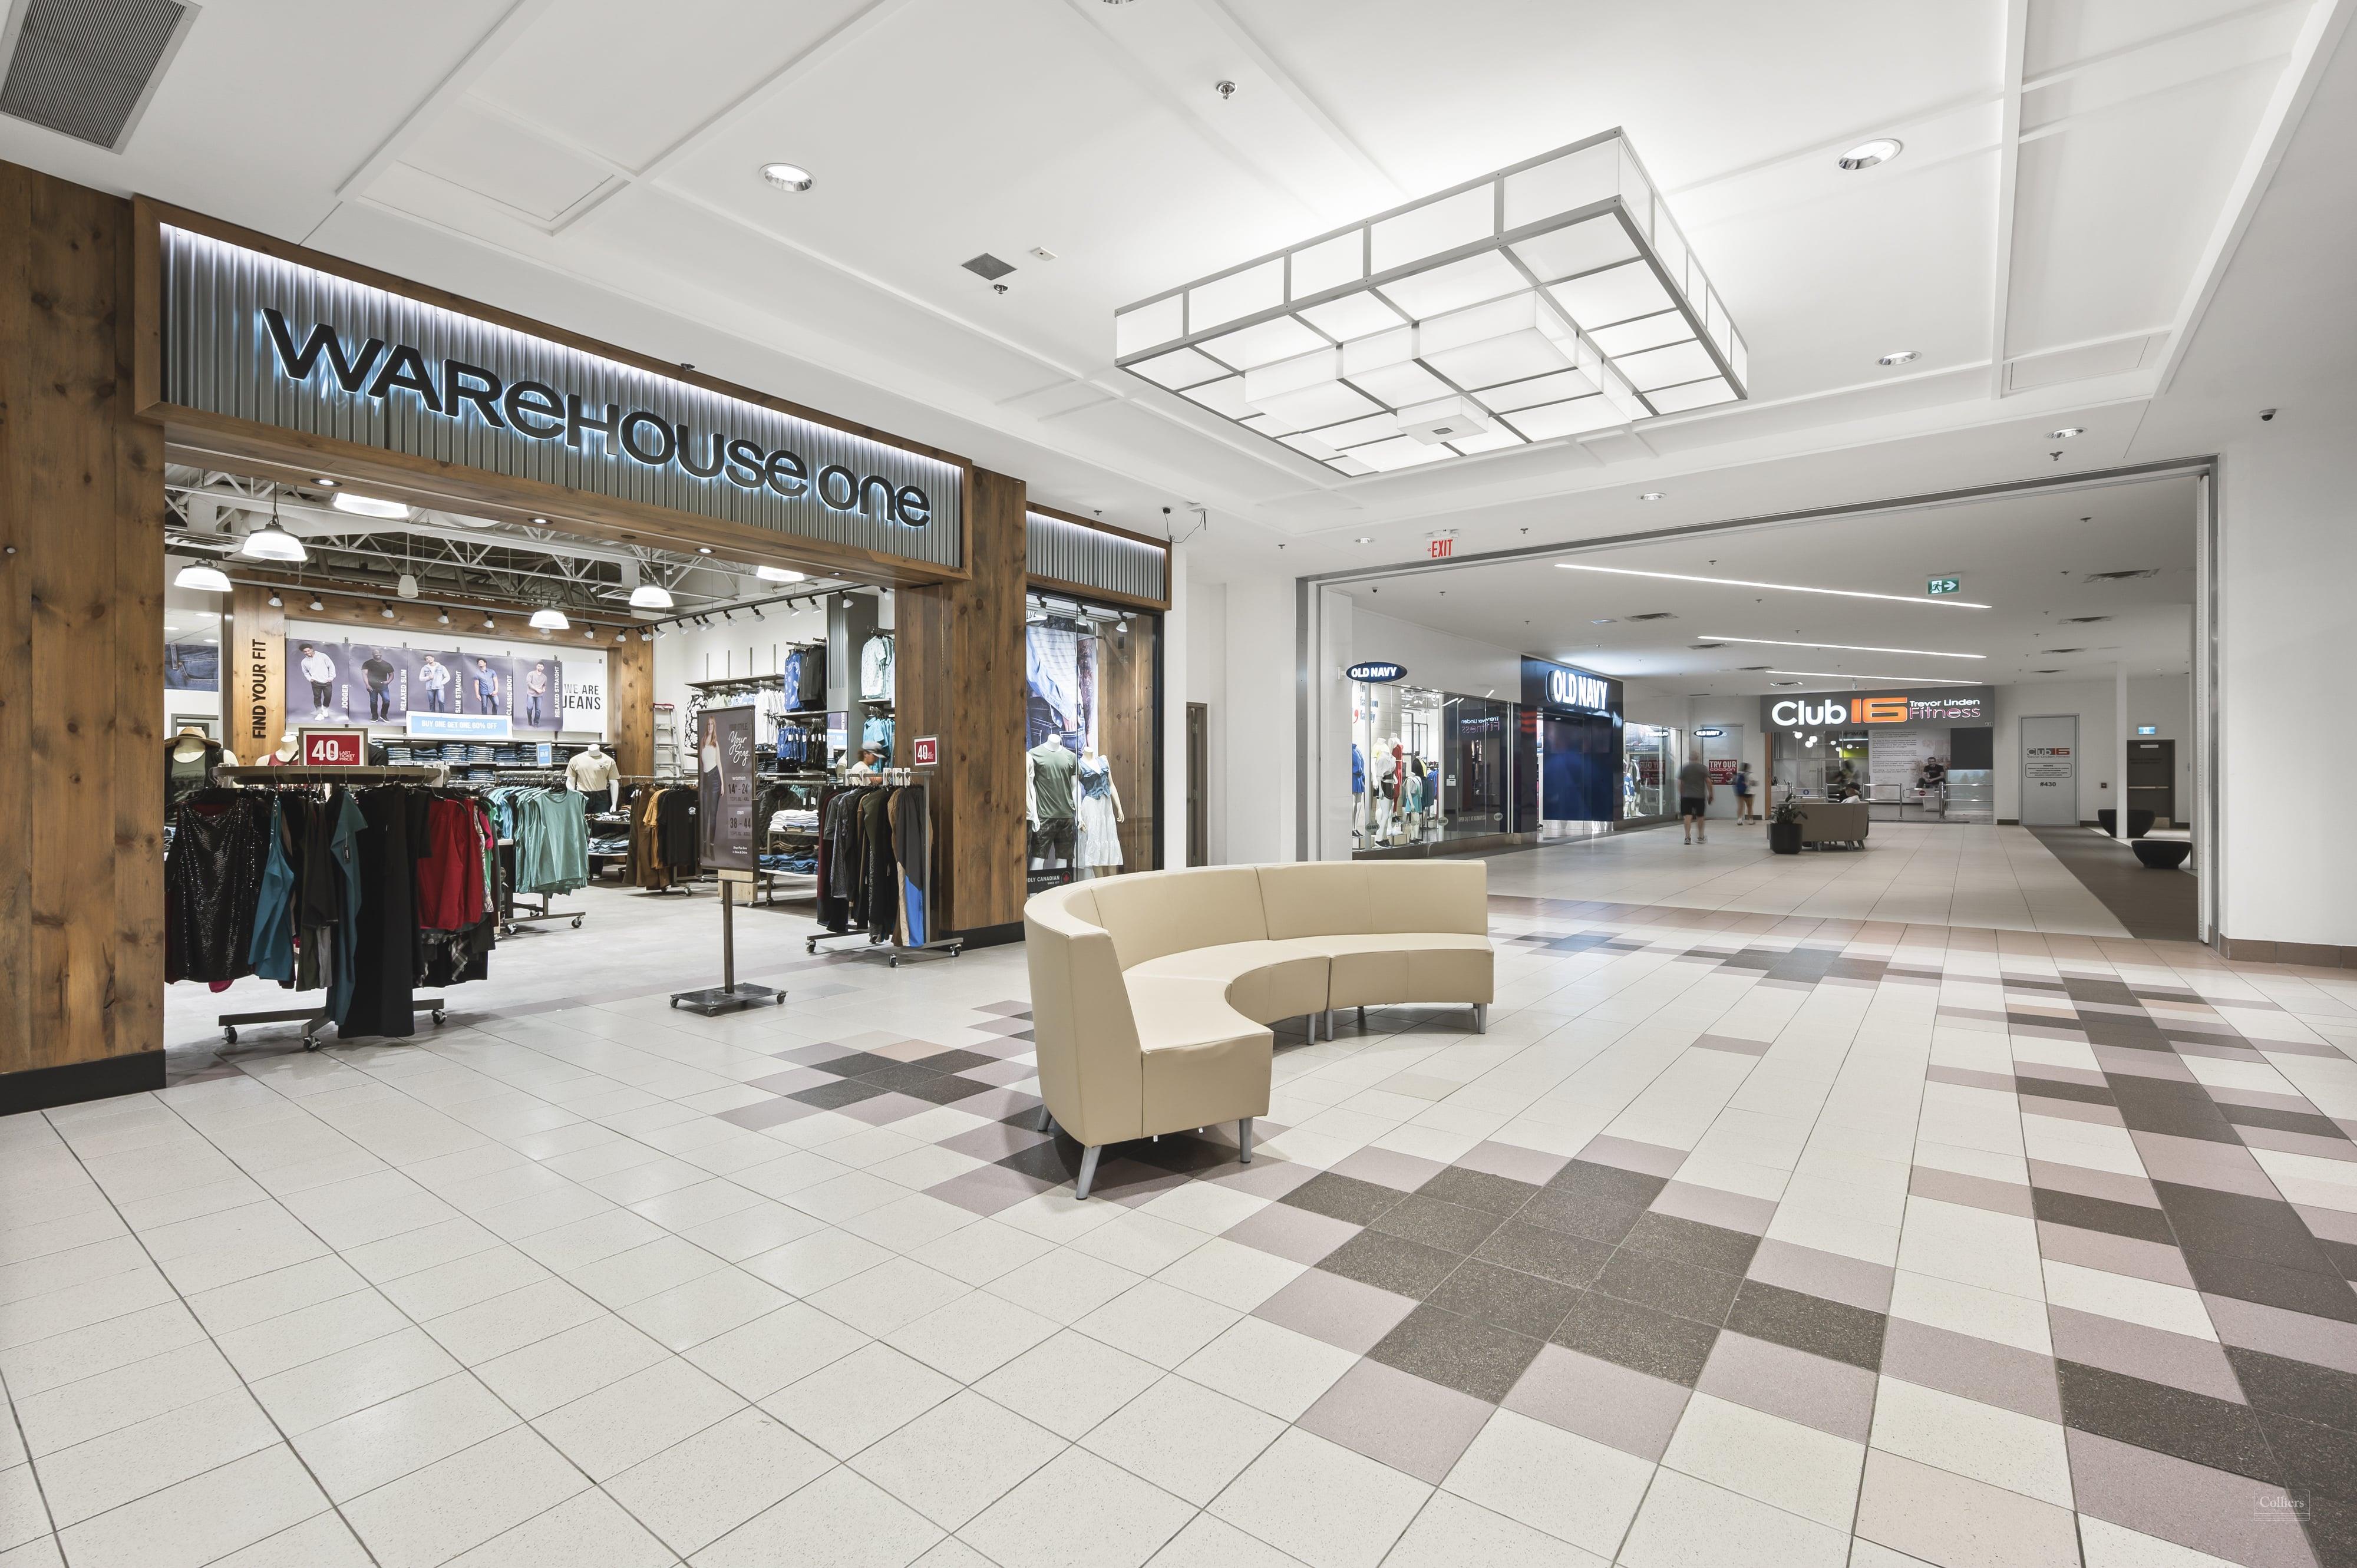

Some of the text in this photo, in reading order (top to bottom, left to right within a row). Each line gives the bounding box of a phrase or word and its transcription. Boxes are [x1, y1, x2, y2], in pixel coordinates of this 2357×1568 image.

[1431, 539, 1453, 557] EXIT
[1351, 667, 1397, 677] OLD NAVY
[252, 639, 266, 739] FIND YOUR FIT
[565, 684, 599, 695] WE ARE
[1553, 669, 1607, 710] OLD NAVY
[562, 695, 601, 710] JEANS
[1772, 699, 1847, 726] Club
[1909, 707, 1980, 719] Fitness
[312, 740, 338, 761] 40
[728, 731, 747, 755] Your
[917, 744, 928, 760] 40
[730, 817, 738, 829] 38
[744, 817, 751, 829] 44
